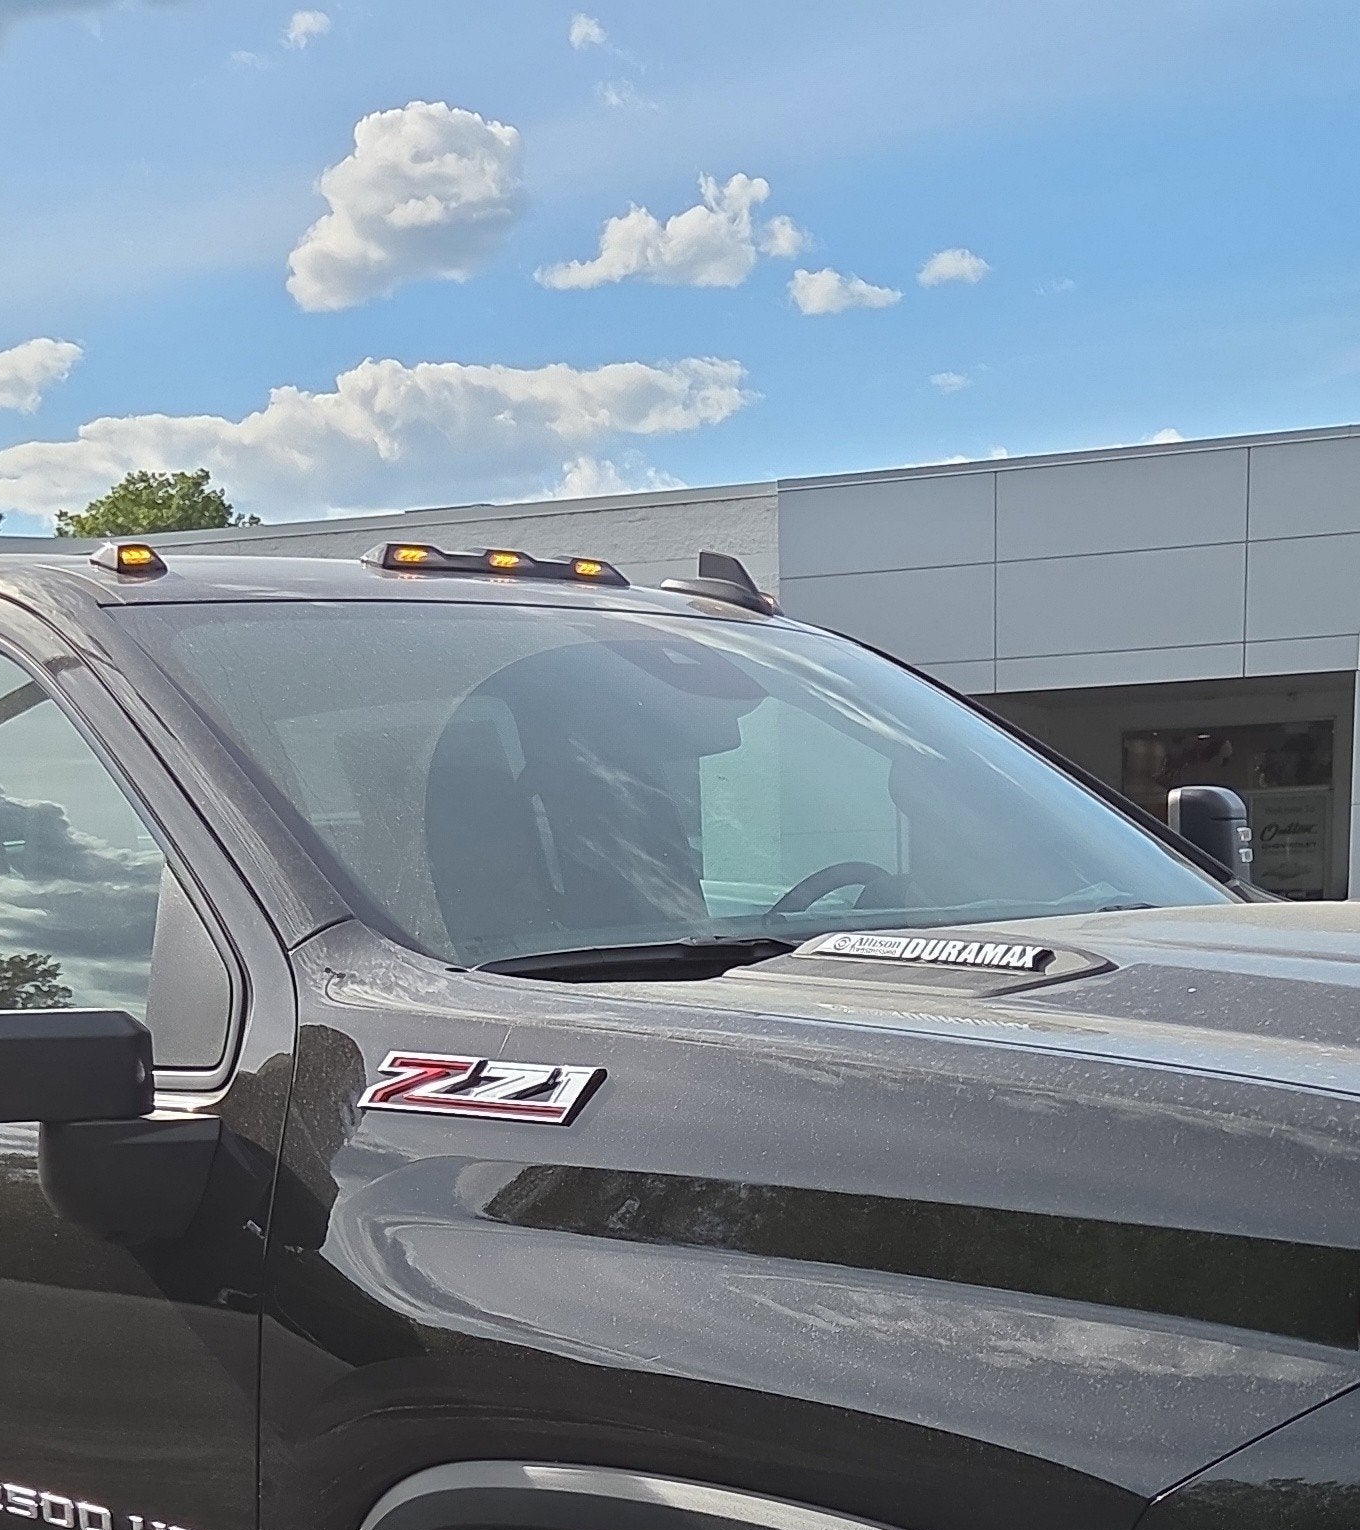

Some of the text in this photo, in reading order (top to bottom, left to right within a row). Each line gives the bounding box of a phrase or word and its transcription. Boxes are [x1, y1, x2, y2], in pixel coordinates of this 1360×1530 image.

[851, 937, 902, 951] Allison
[901, 938, 1045, 968] DURAMAX
[357, 1050, 603, 1124] Z71
